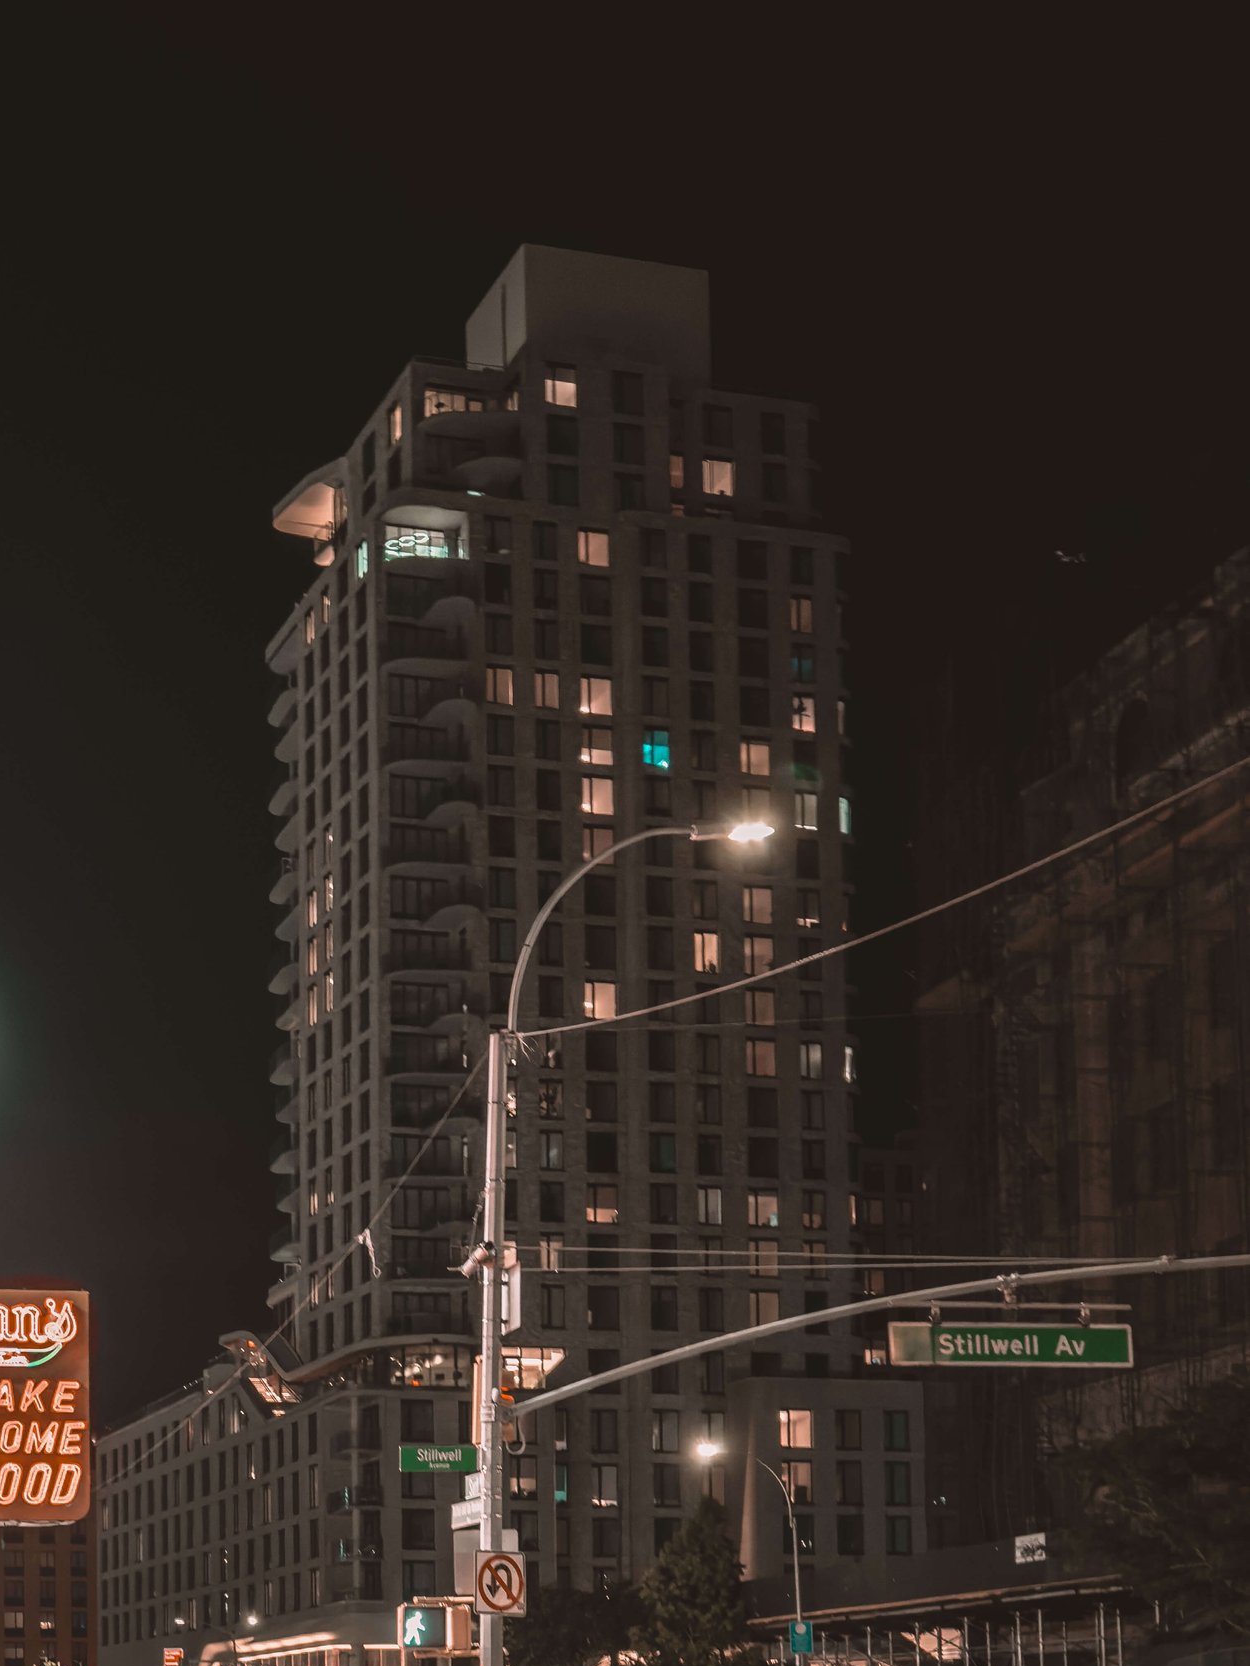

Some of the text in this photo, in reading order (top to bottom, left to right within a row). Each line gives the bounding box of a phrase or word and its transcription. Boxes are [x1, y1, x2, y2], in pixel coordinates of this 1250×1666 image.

[938, 1333, 1087, 1356] Stillwell Av
[416, 1448, 462, 1462] Stillwell
